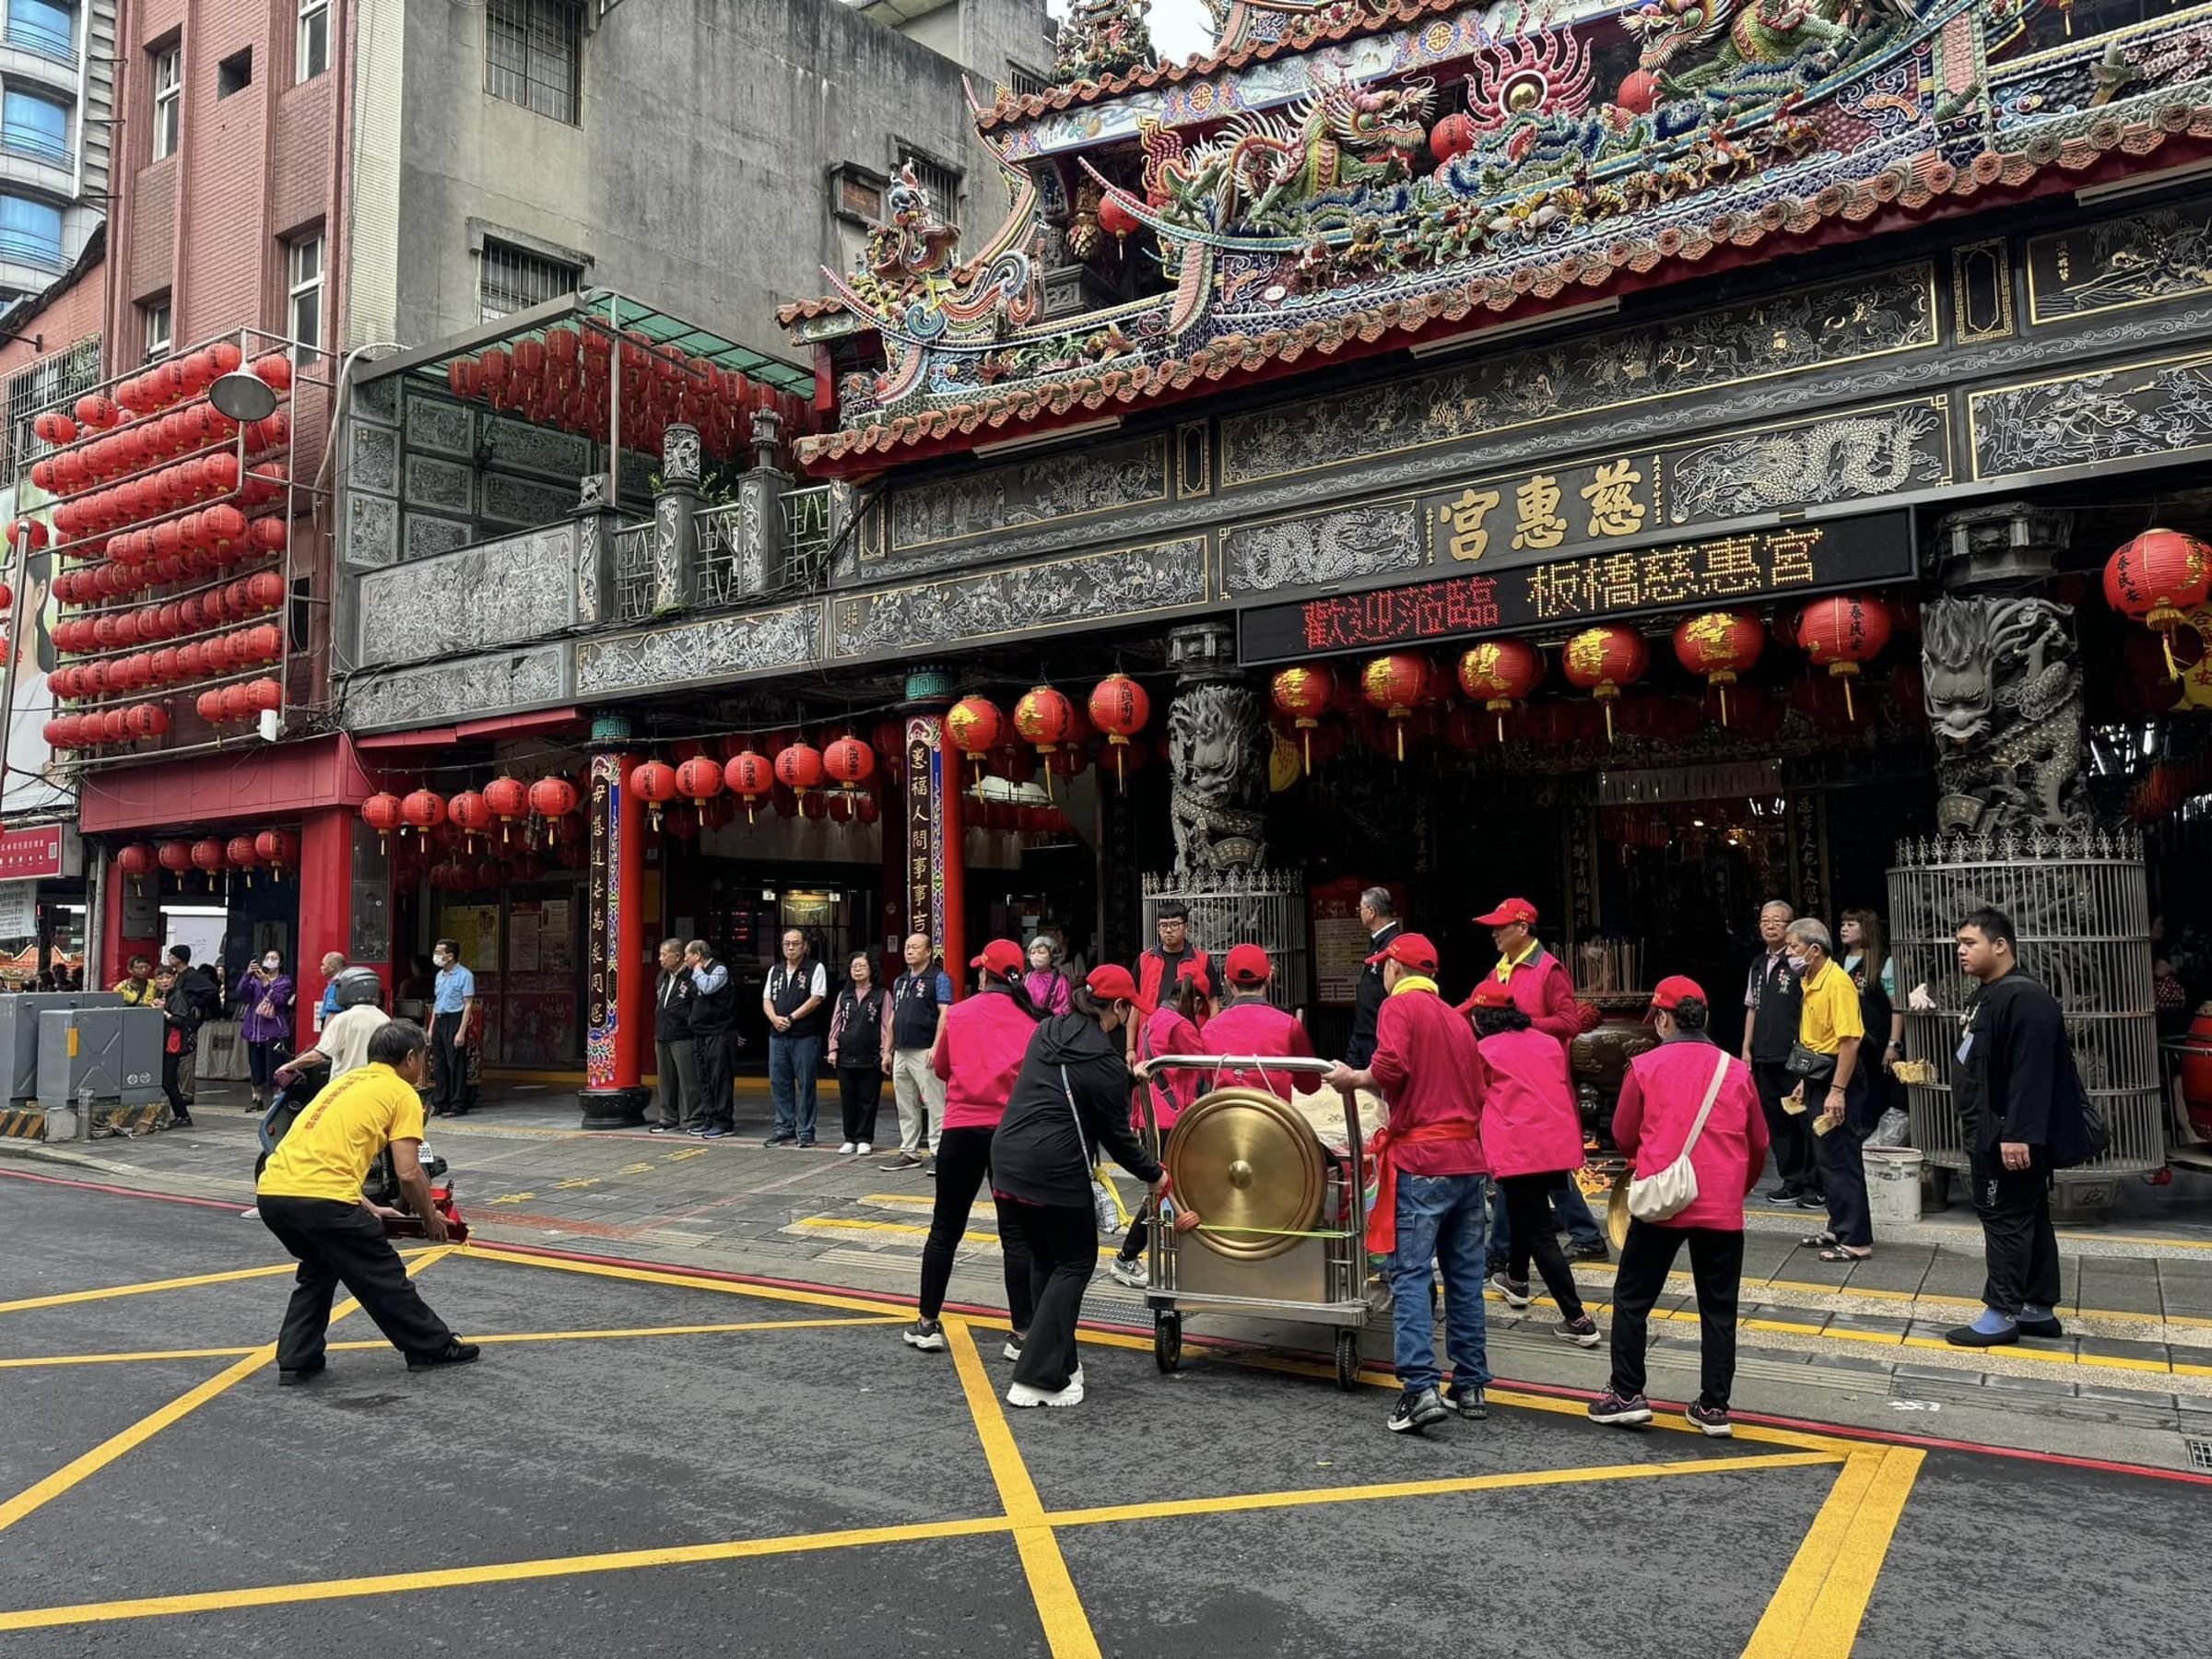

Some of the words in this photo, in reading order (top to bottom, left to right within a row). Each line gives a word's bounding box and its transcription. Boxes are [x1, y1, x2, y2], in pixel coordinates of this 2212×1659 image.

[1440, 458, 1645, 561] 慈惠宮
[1526, 527, 1823, 619] 板橋慈惠宮
